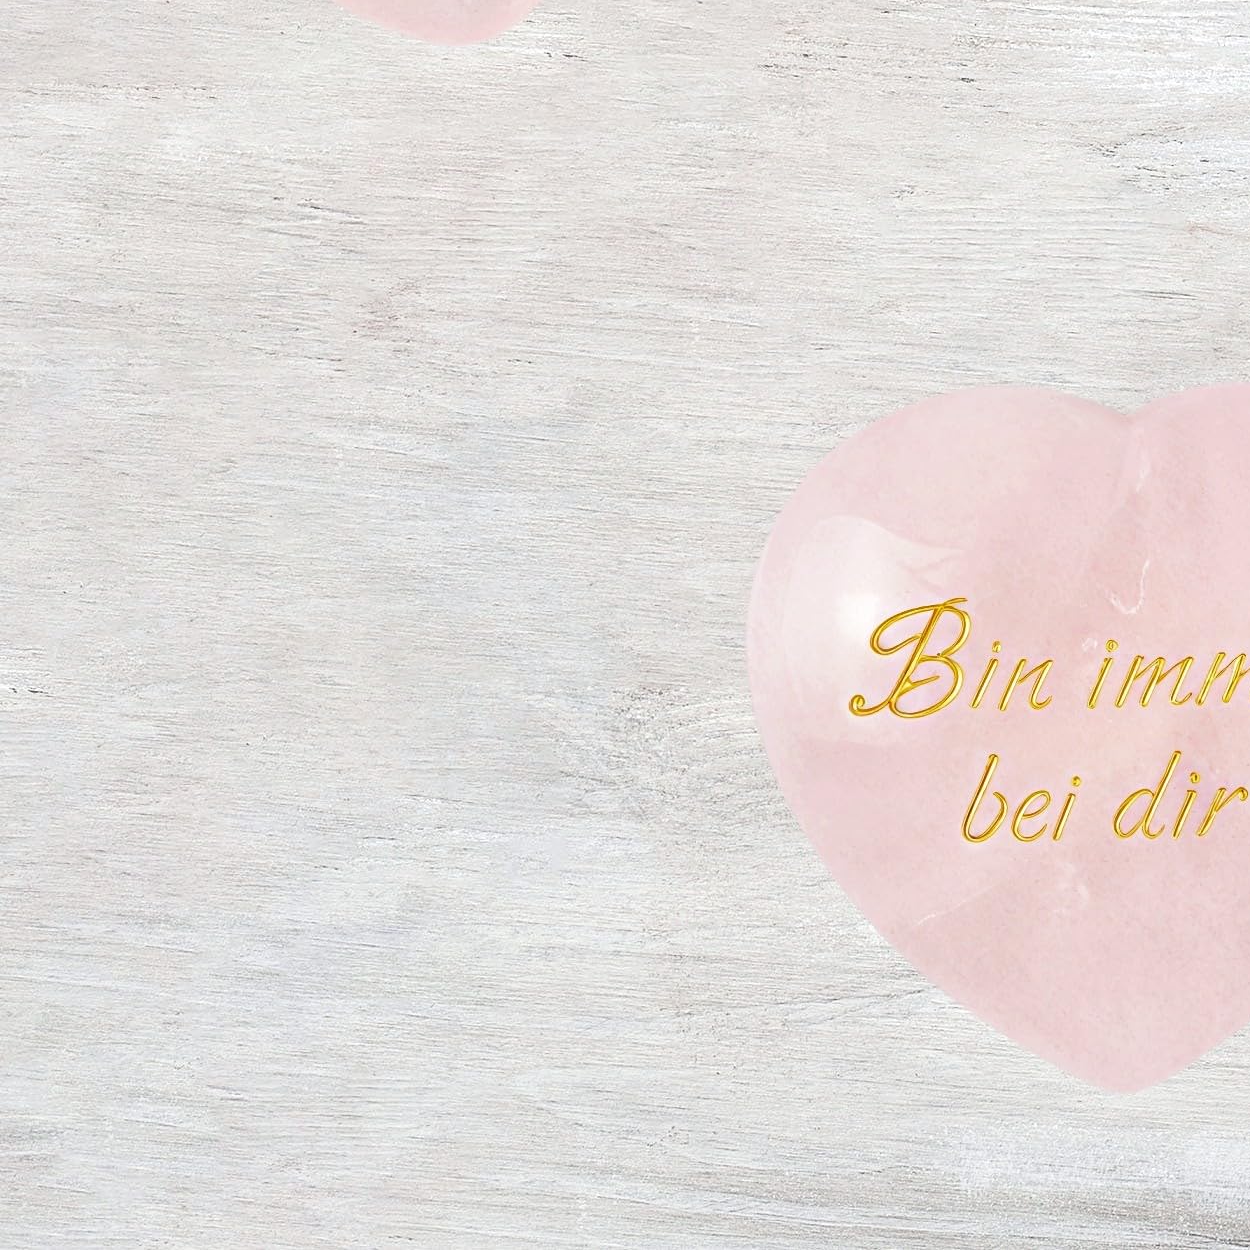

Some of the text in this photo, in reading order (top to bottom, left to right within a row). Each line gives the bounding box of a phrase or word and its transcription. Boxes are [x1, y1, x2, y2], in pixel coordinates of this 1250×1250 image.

[848, 596, 1054, 719] Bin
[960, 749, 1249, 844] bei dir
